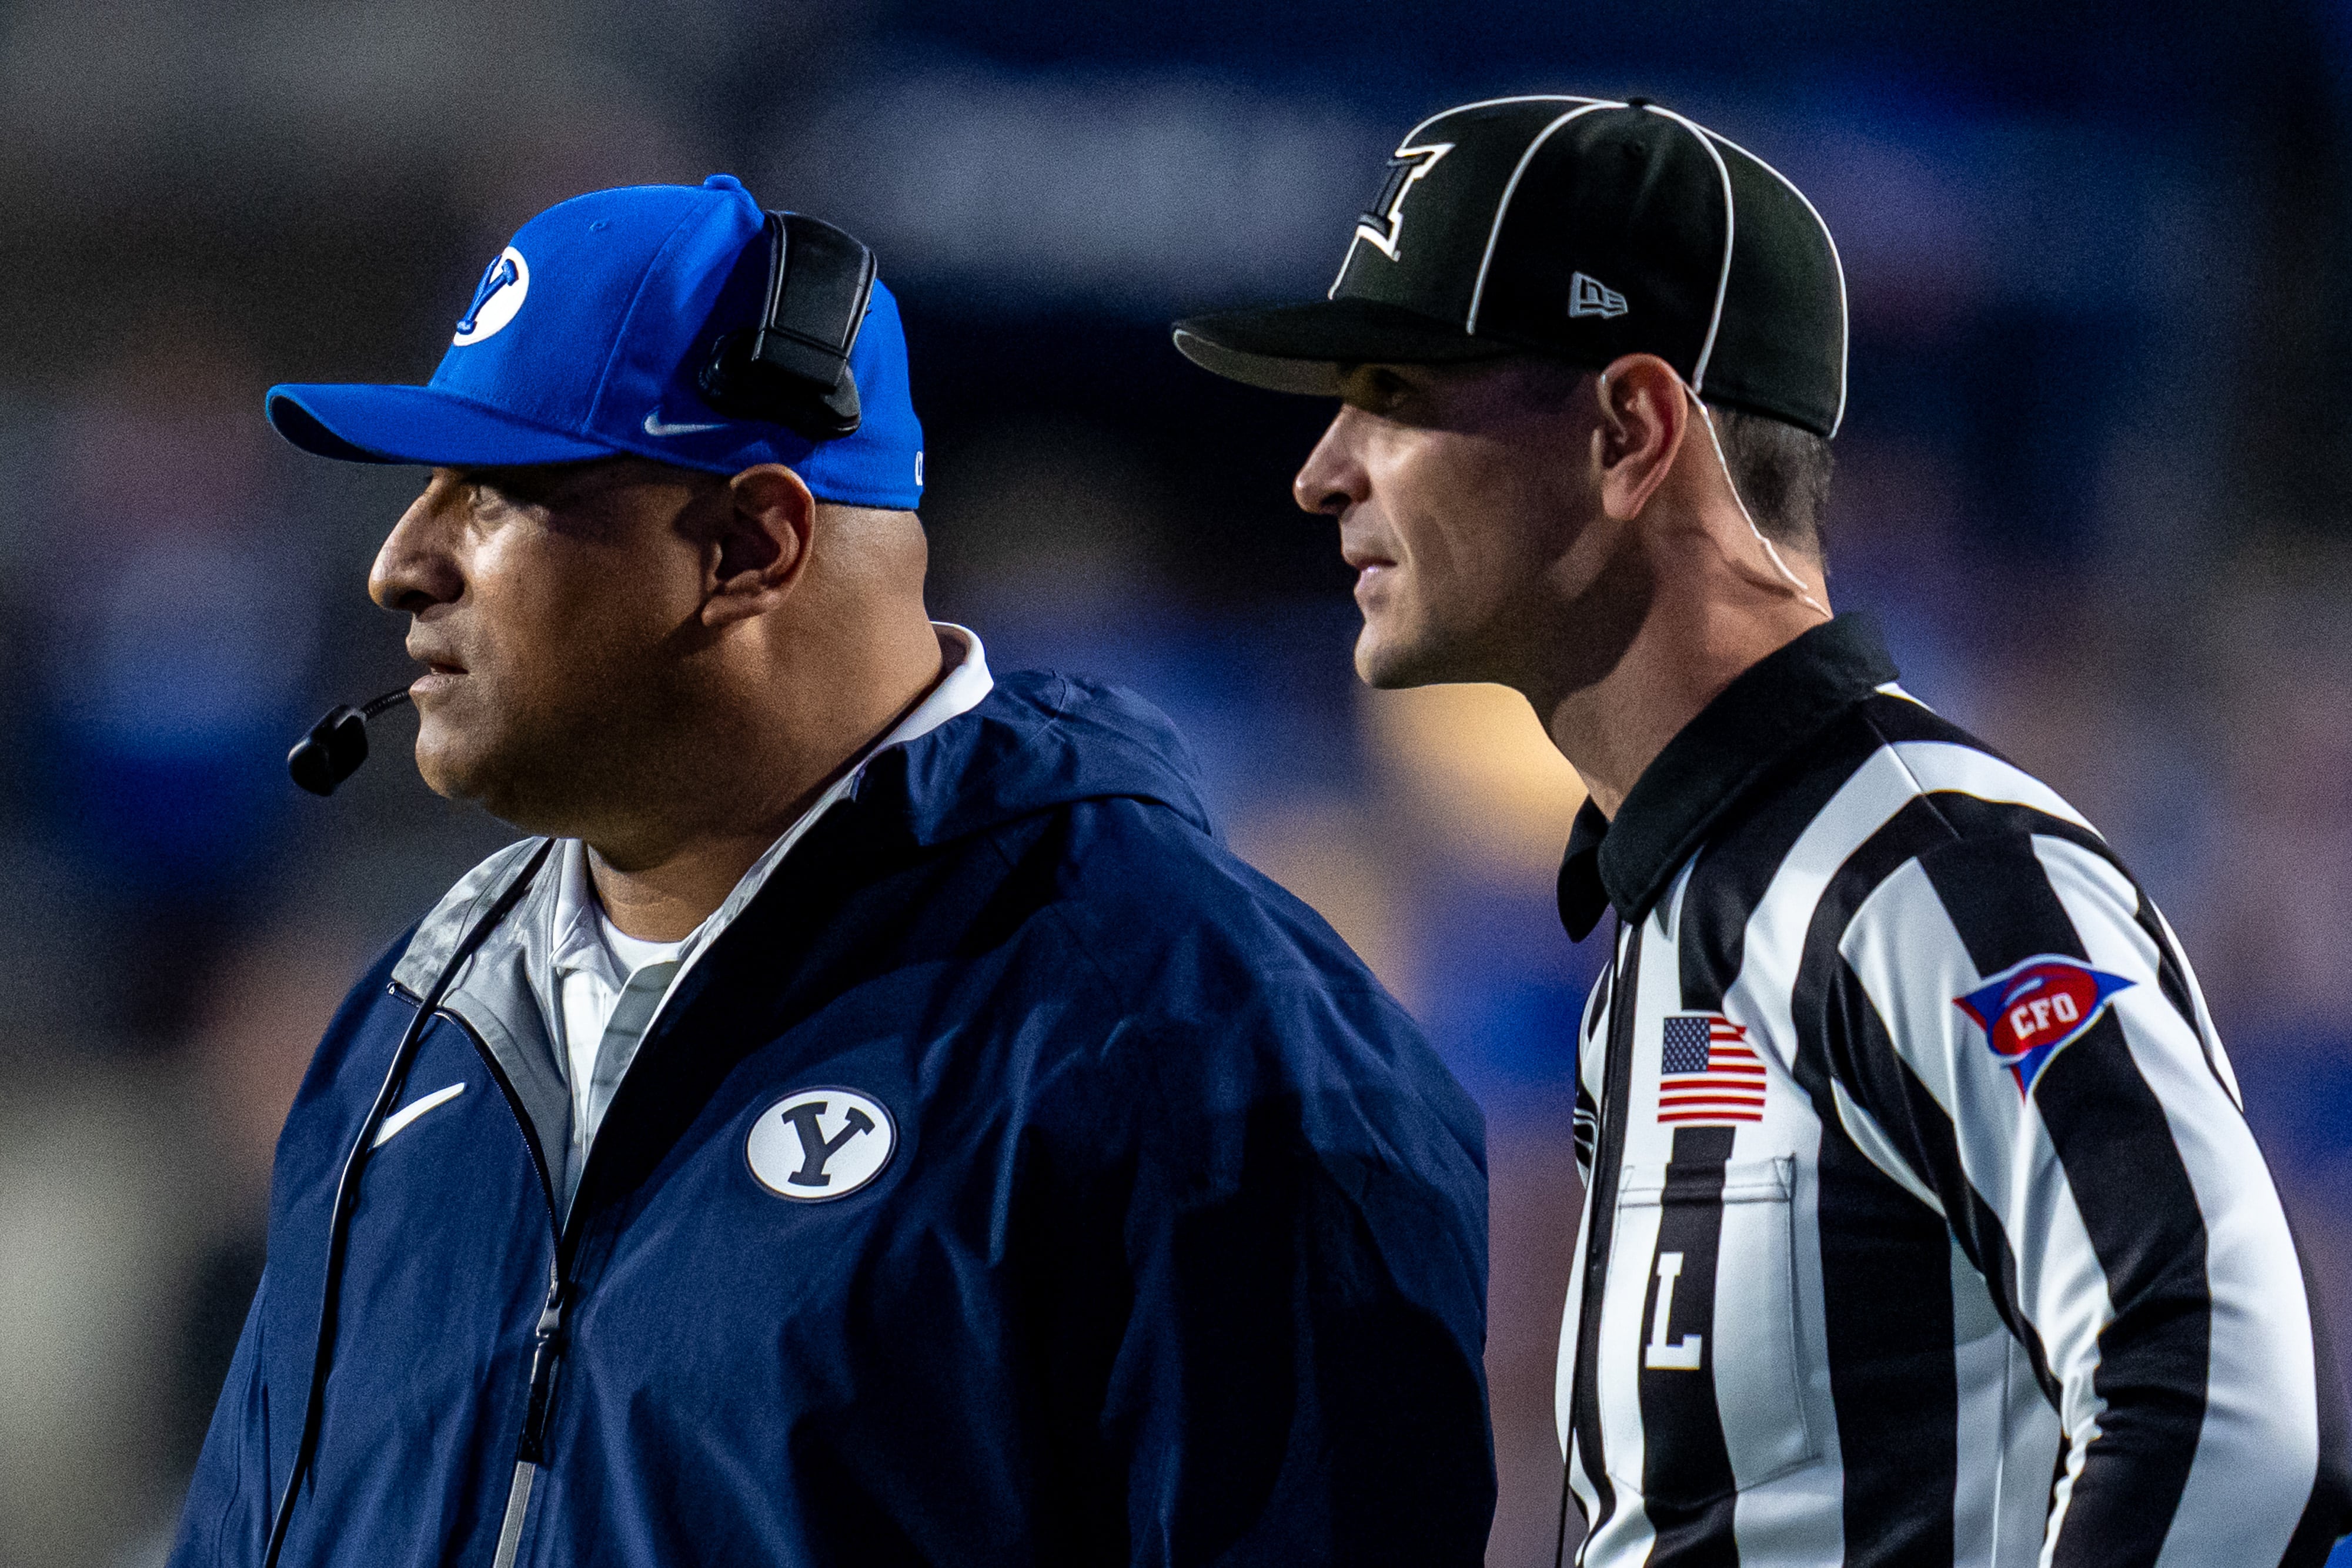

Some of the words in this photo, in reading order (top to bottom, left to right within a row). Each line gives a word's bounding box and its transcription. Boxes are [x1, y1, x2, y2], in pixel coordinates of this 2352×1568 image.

[457, 254, 519, 335] Y
[2009, 992, 2079, 1039] CFO
[781, 1101, 875, 1186] Y
[1646, 1252, 1702, 1370] L
